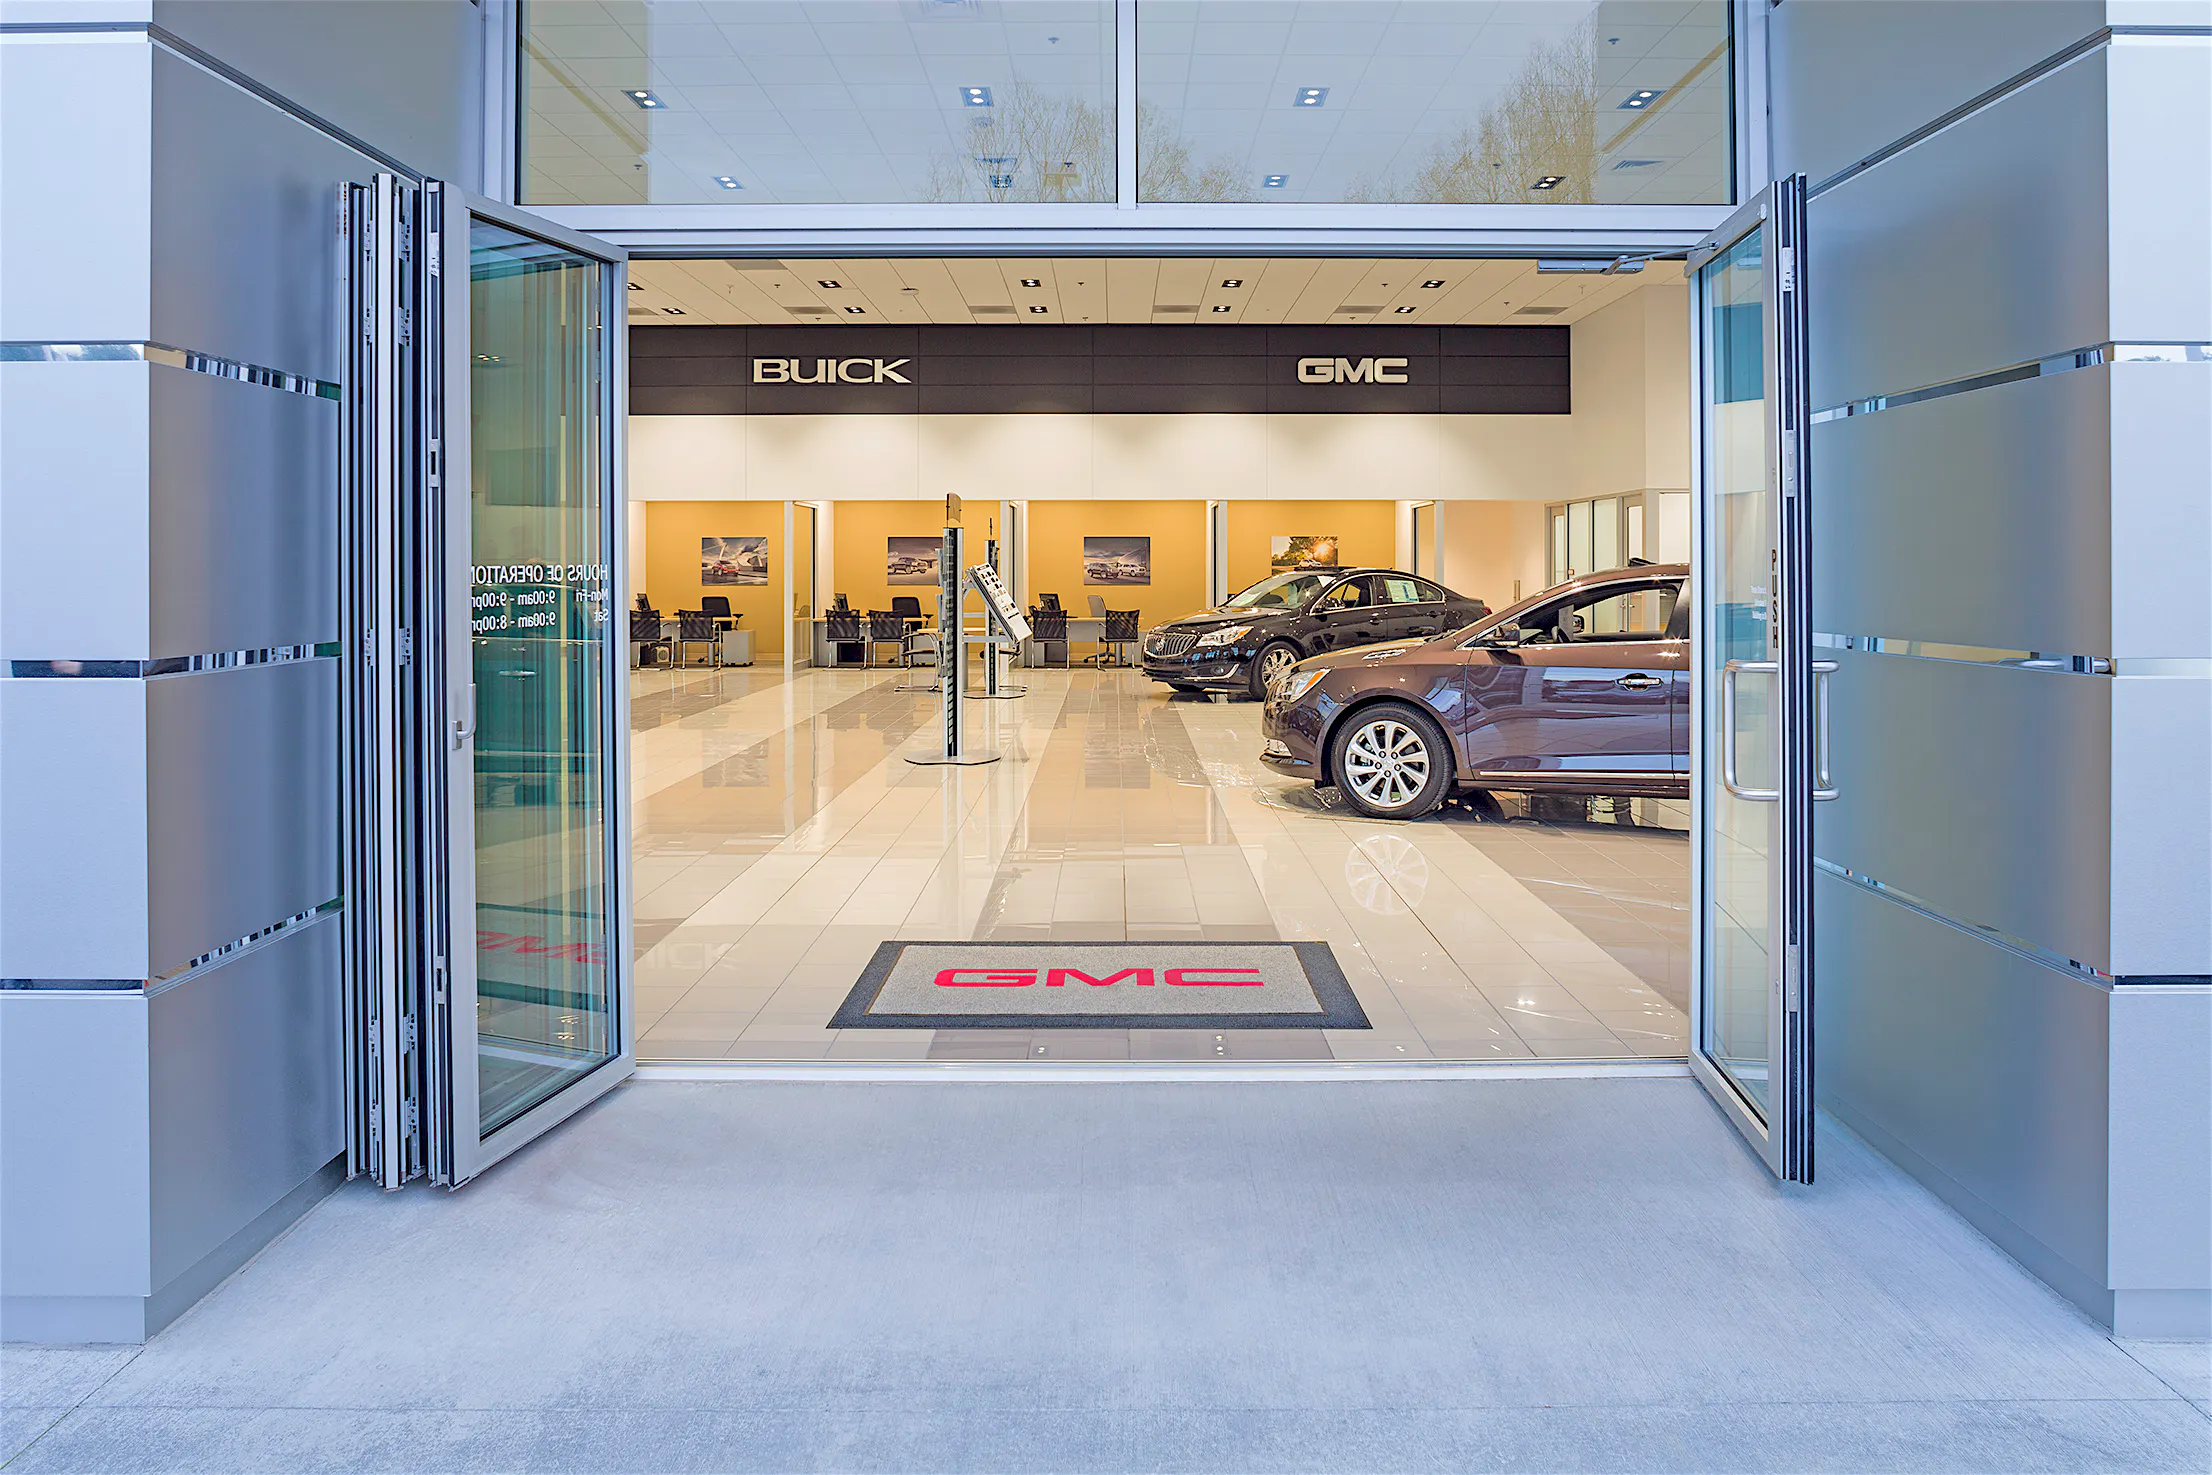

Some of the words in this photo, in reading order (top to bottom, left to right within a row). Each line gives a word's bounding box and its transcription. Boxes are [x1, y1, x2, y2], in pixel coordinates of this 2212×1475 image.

[753, 358, 912, 384] BUICK
[1297, 357, 1408, 384] GMC
[1771, 548, 1779, 649] PUSH
[933, 968, 1265, 988] GMC
